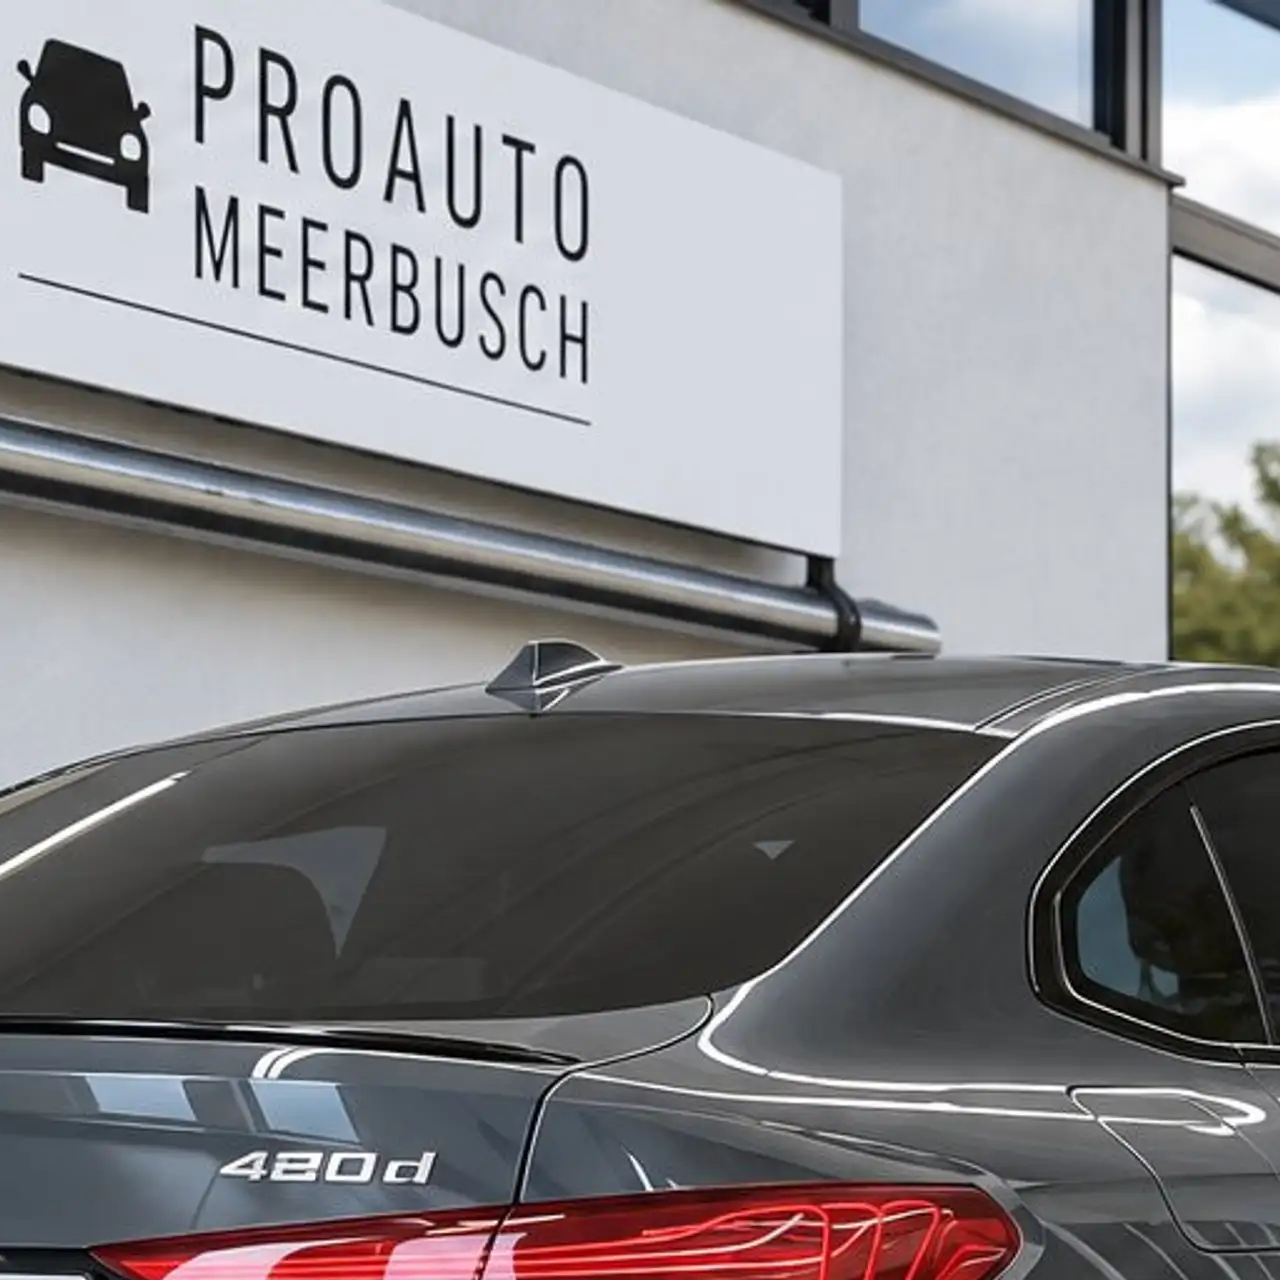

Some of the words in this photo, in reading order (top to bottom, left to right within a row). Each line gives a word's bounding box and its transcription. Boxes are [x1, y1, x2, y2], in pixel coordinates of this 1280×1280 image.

[194, 24, 590, 263] PROAUTO
[194, 185, 590, 385] MEERBUSCH
[219, 1151, 437, 1184] 420d
